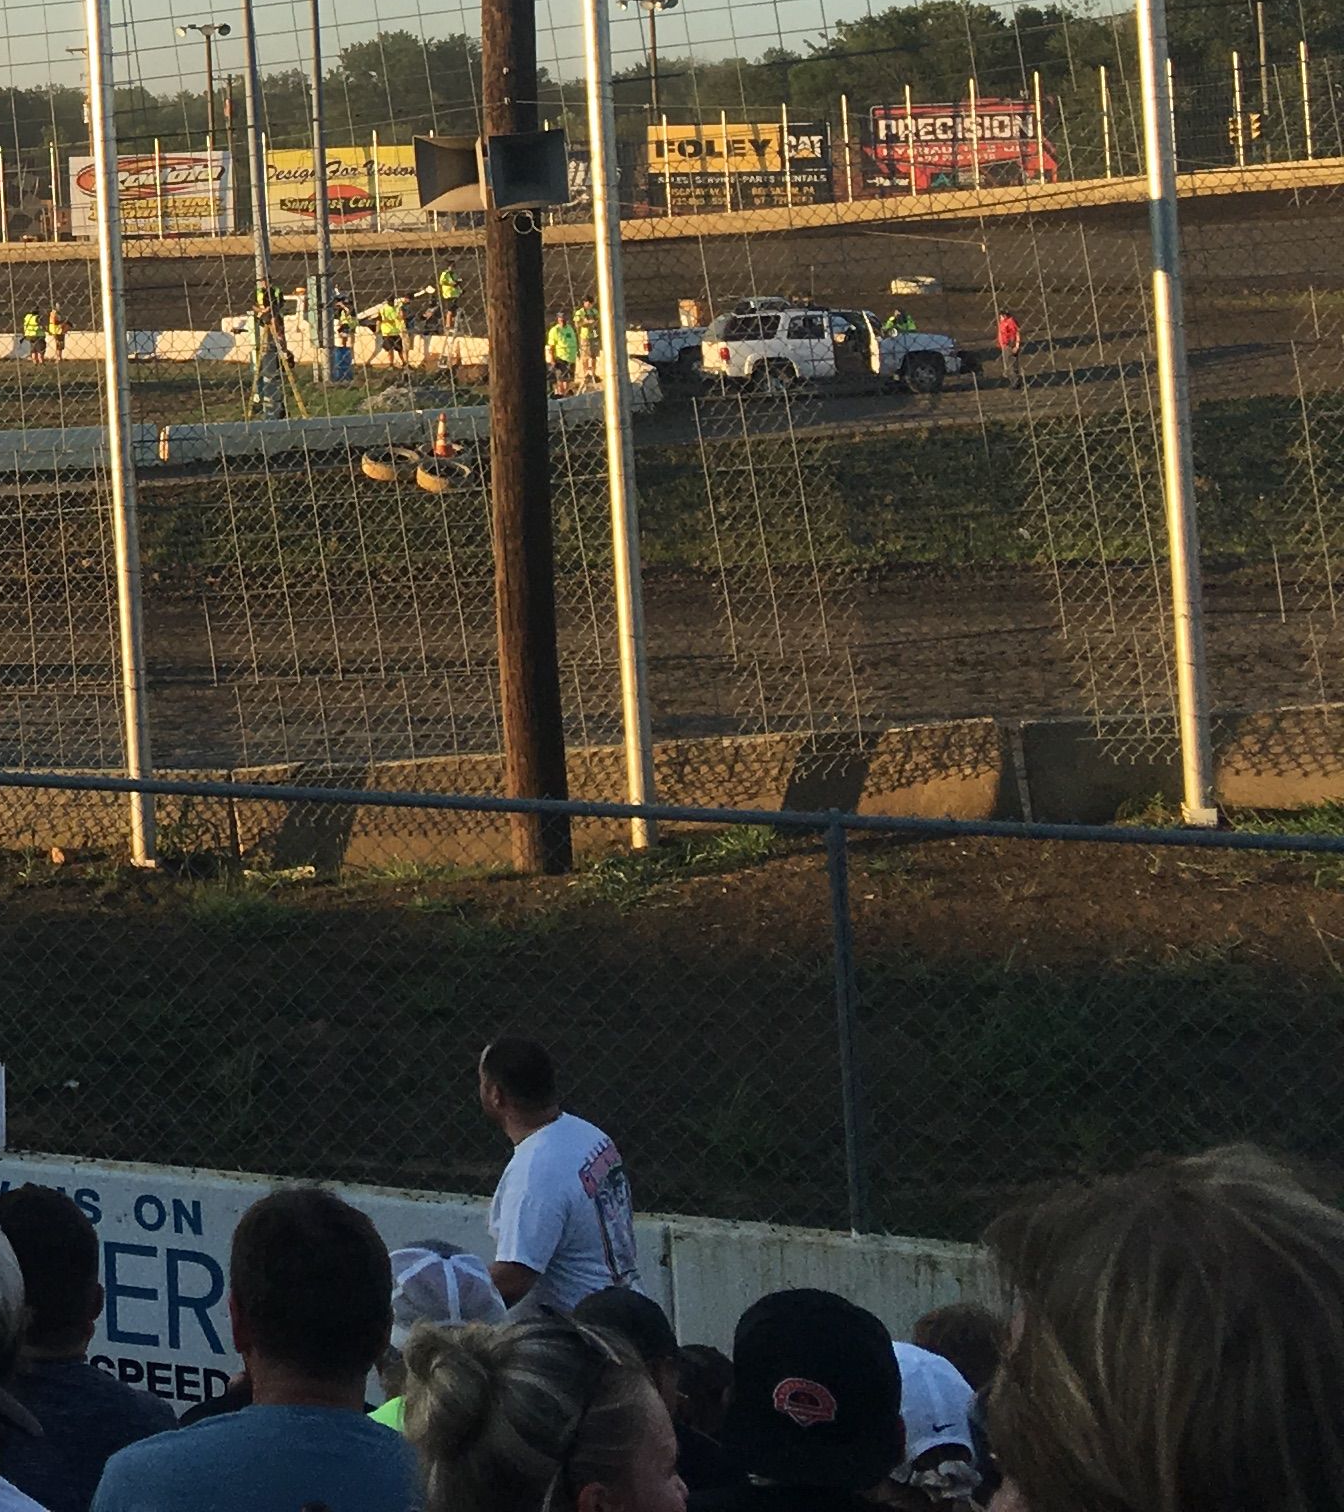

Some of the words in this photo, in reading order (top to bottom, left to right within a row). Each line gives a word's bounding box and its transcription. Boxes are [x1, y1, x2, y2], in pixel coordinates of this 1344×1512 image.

[878, 116, 1034, 141] PRECISION
[655, 138, 773, 159] FOLEY
[134, 1194, 204, 1236] ON
